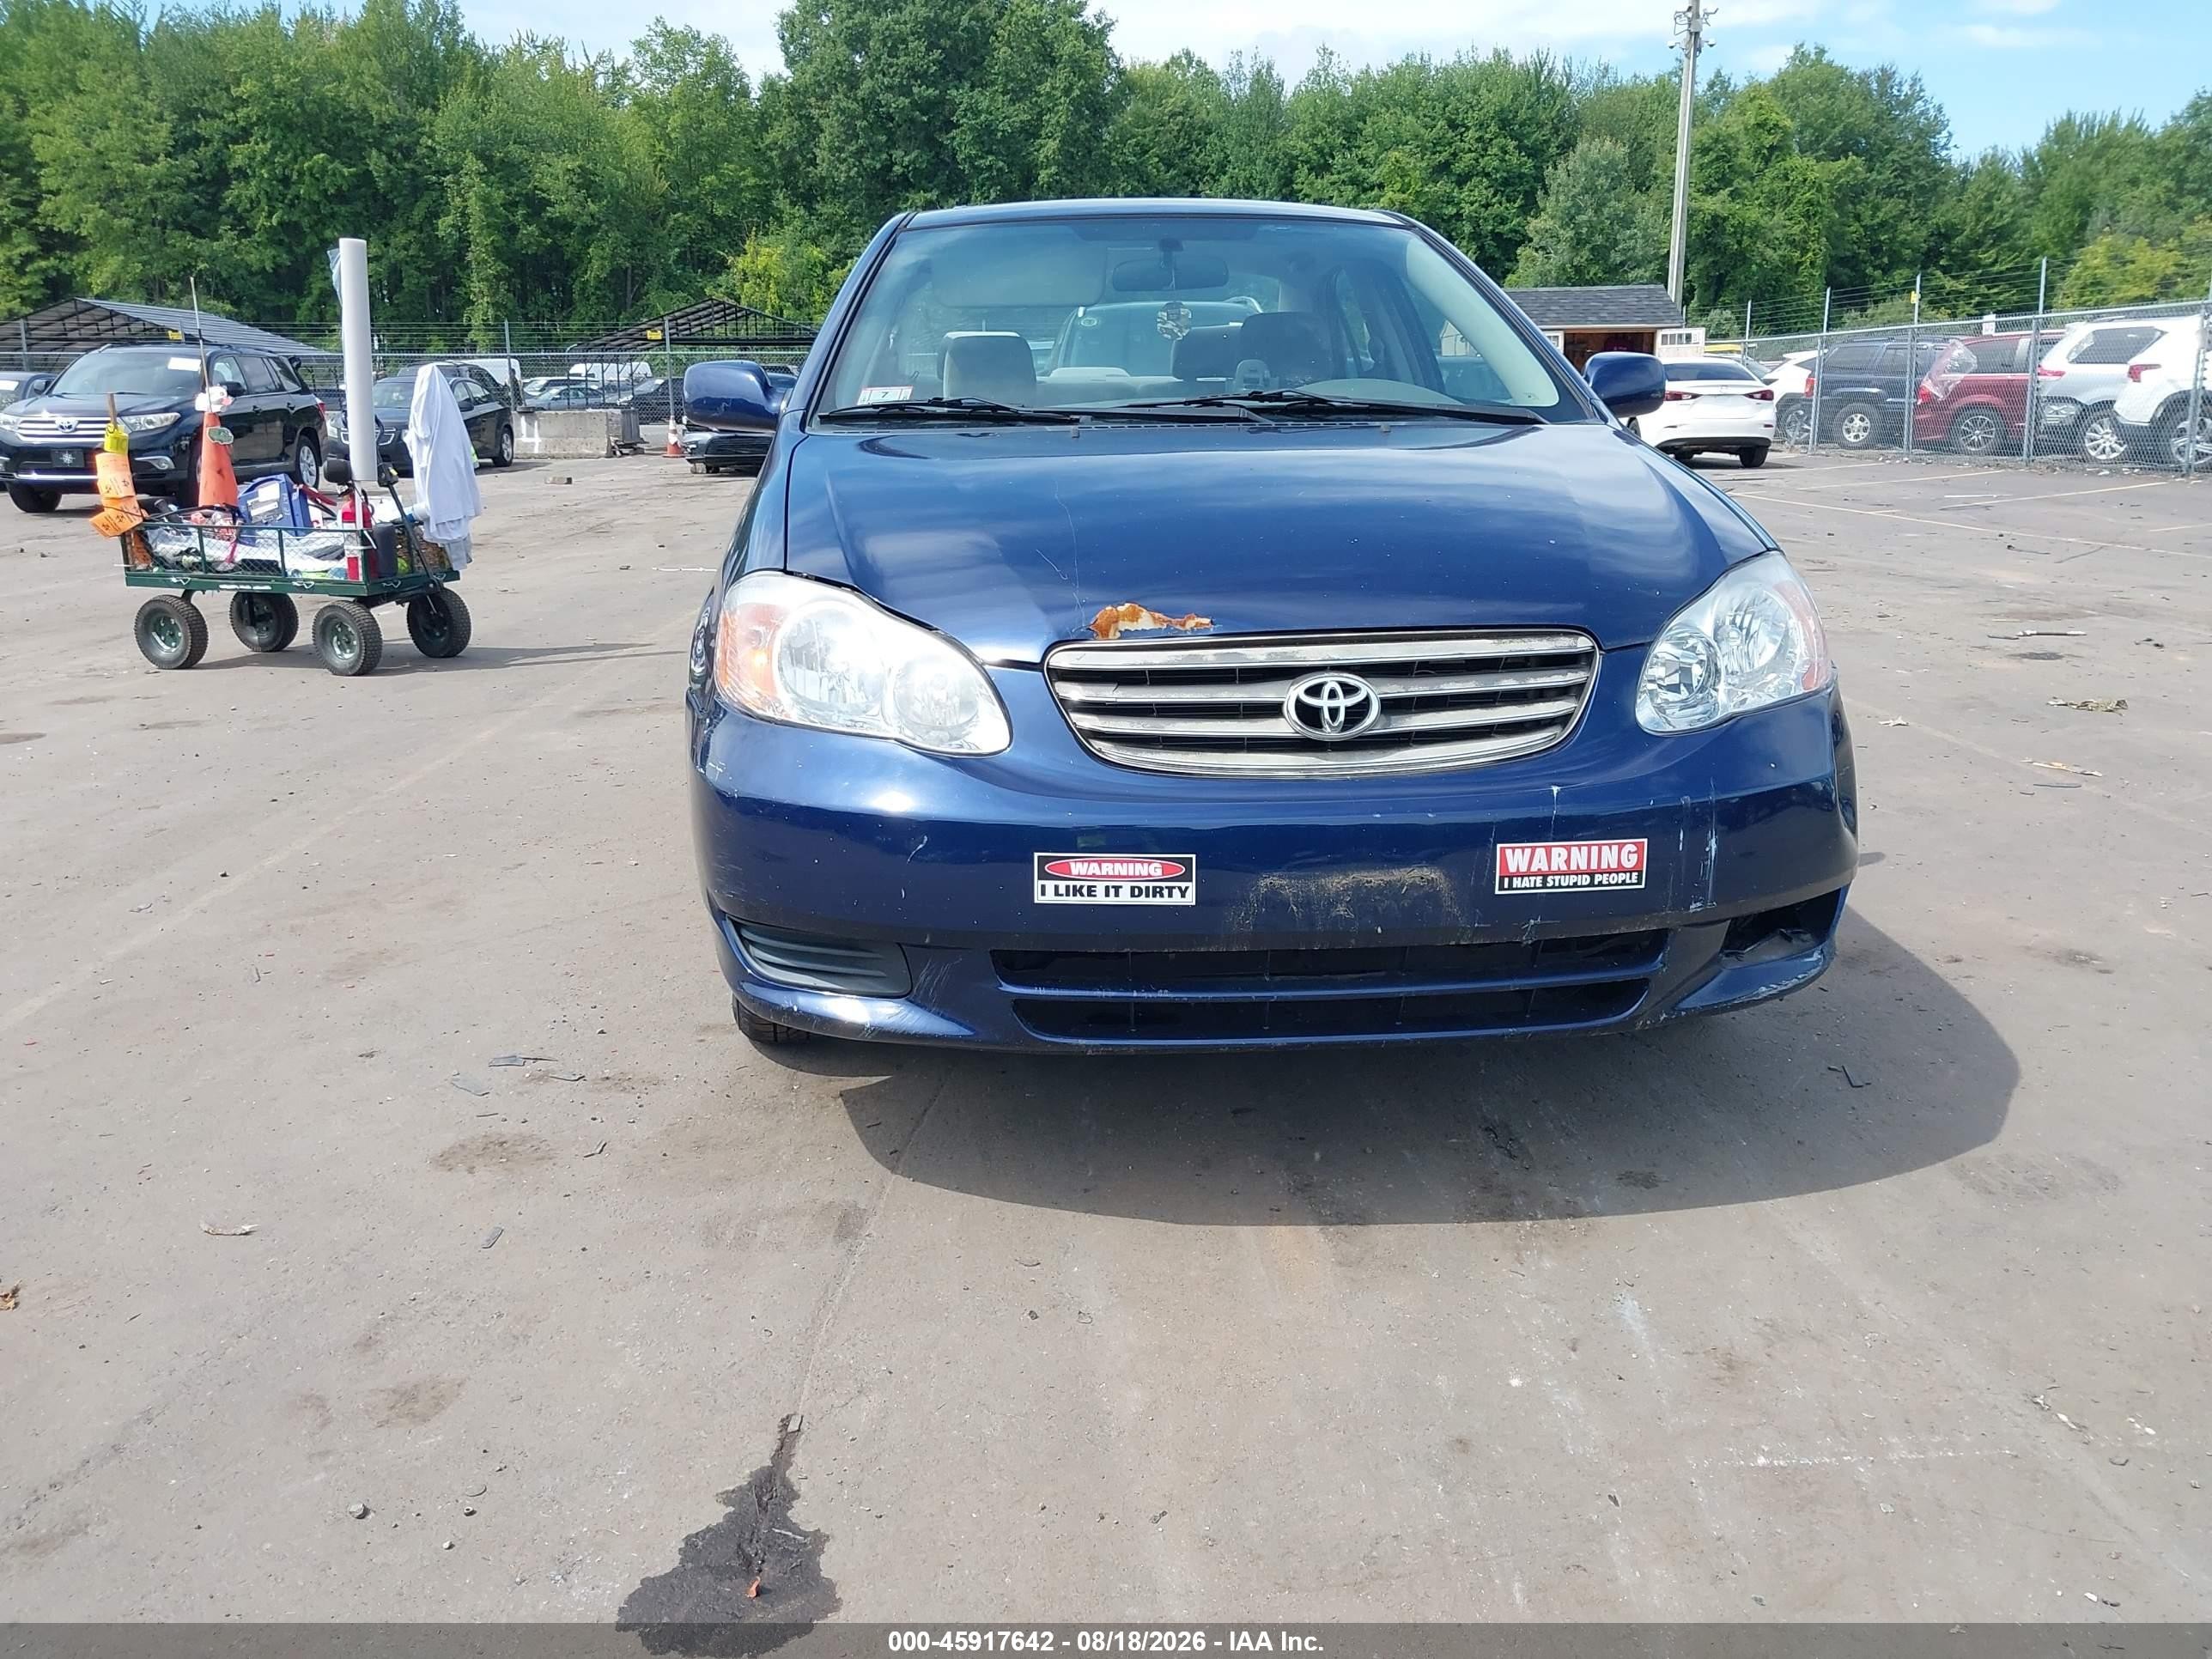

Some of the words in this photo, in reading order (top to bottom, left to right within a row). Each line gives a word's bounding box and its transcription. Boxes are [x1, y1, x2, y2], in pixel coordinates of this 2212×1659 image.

[1504, 843, 1638, 872] WARNING
[1069, 862, 1163, 876] WARNING
[1504, 878, 1509, 888] I
[1513, 876, 1542, 888] HATE
[1547, 874, 1590, 887] STUPID
[1595, 872, 1638, 885] PEOPLE
[1041, 884, 1046, 896] I
[1054, 884, 1097, 897] LIKE
[1104, 885, 1122, 897] IT
[1130, 885, 1189, 898] DIRTY
